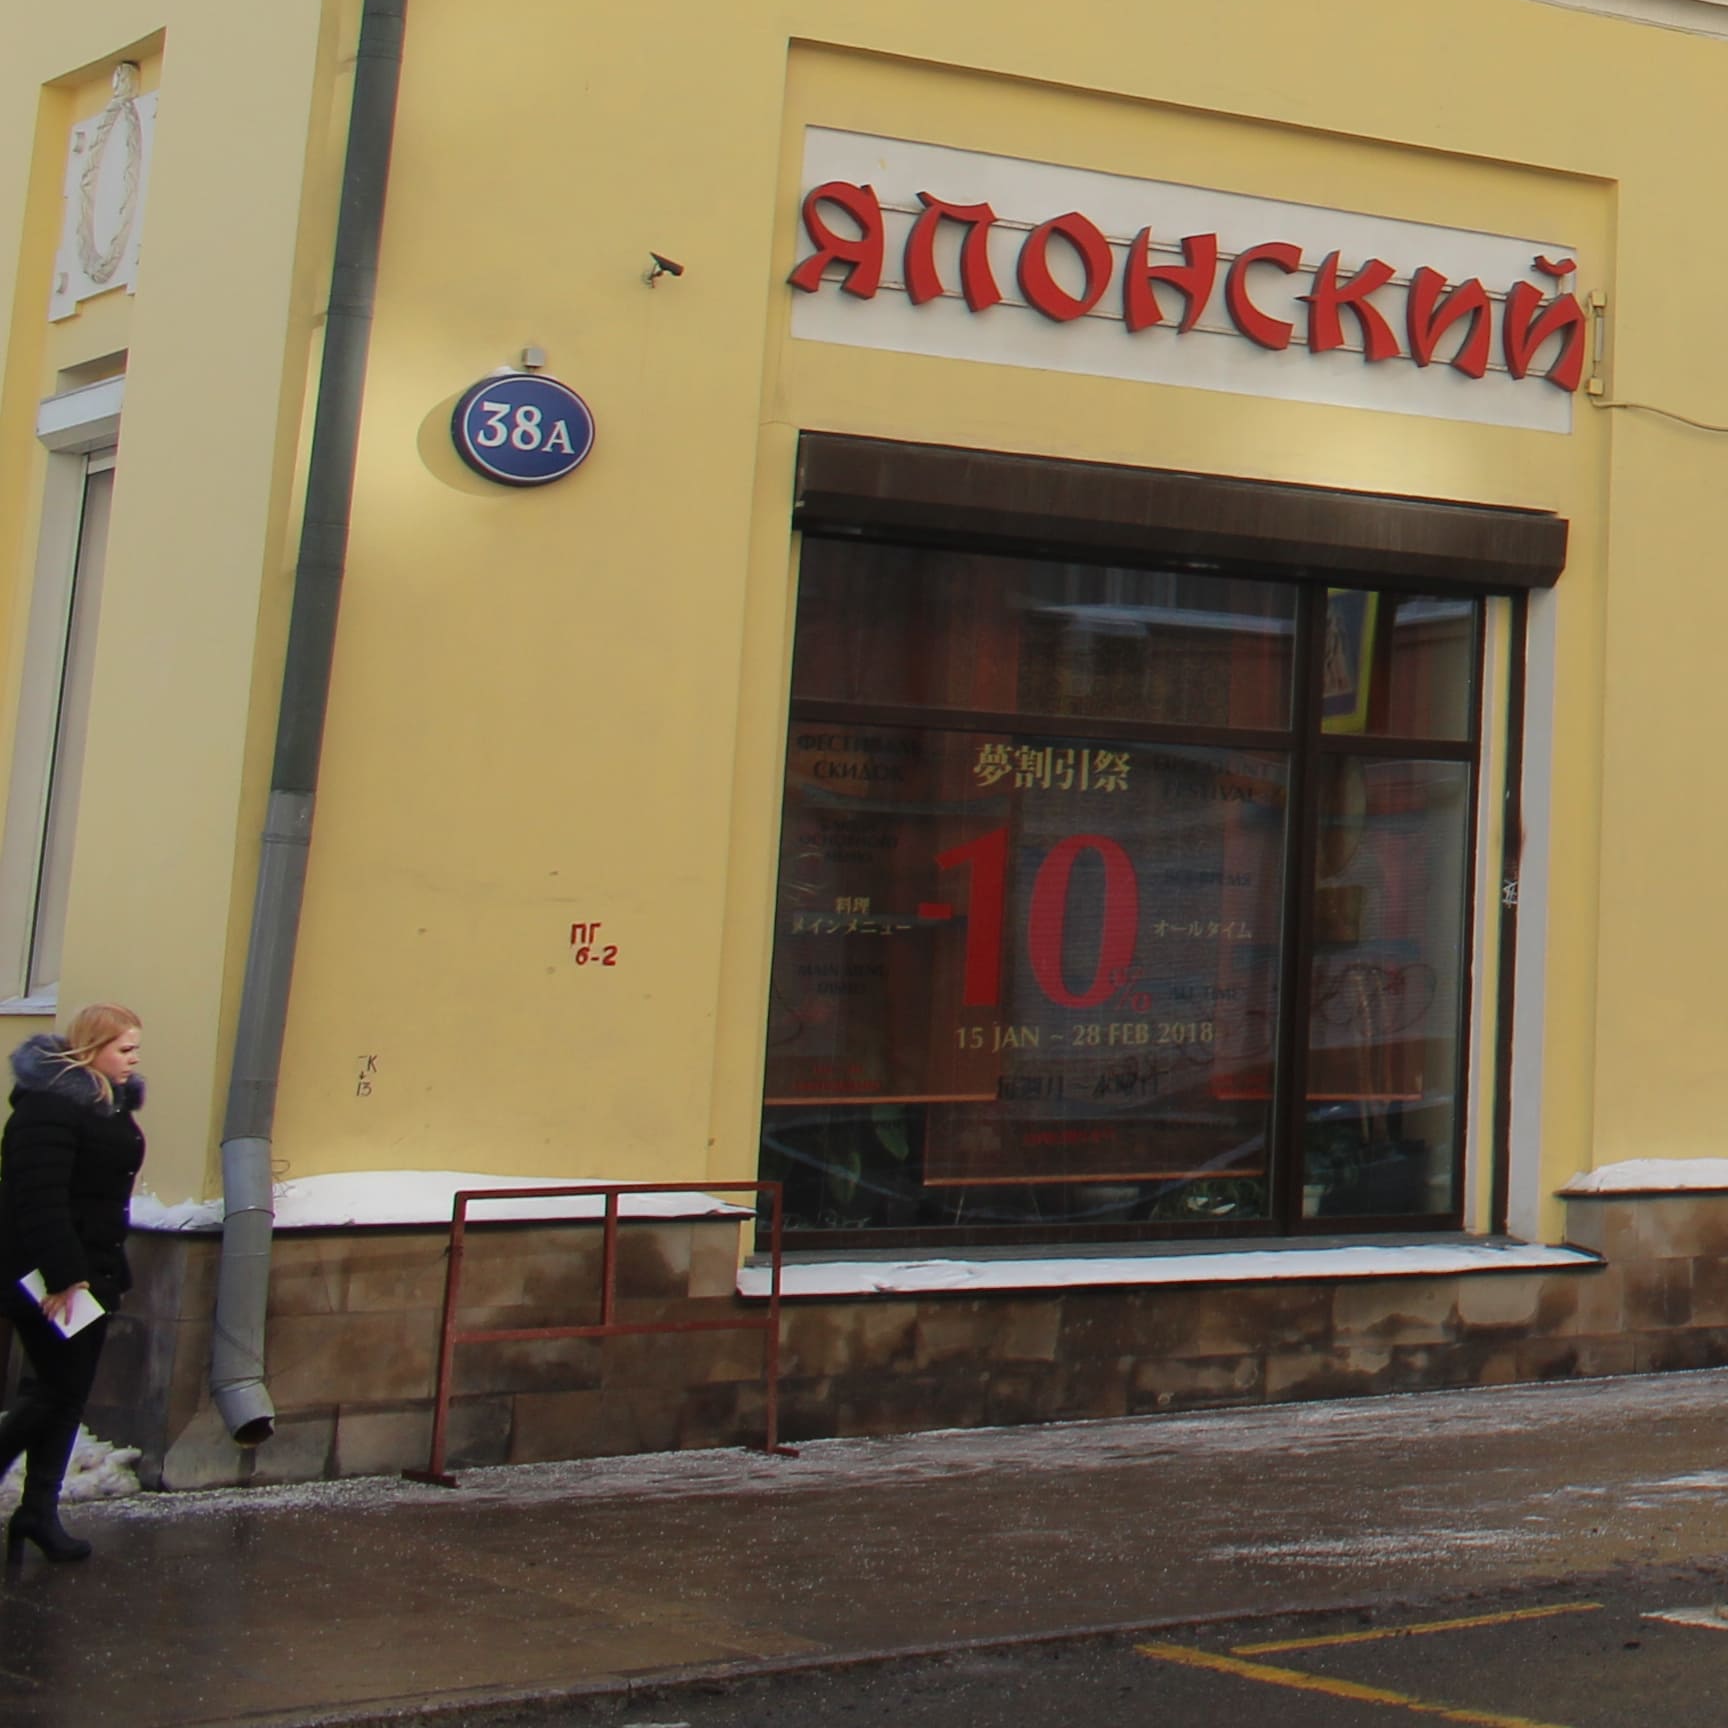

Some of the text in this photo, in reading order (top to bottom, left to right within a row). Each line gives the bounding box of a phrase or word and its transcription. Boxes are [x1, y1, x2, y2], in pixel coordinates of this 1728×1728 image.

[787, 181, 1587, 393] ЯПОНСКИЙ
[477, 401, 576, 454] 38А
[973, 742, 1134, 792] 夢割引祭
[570, 922, 602, 945] ПГ
[575, 945, 619, 966] 6-2
[956, 1026, 985, 1049] 15
[991, 1022, 1040, 1054] JAN
[1071, 1024, 1101, 1047] 28
[1107, 1022, 1150, 1046] FEB
[1156, 1022, 1214, 1044] 2018
